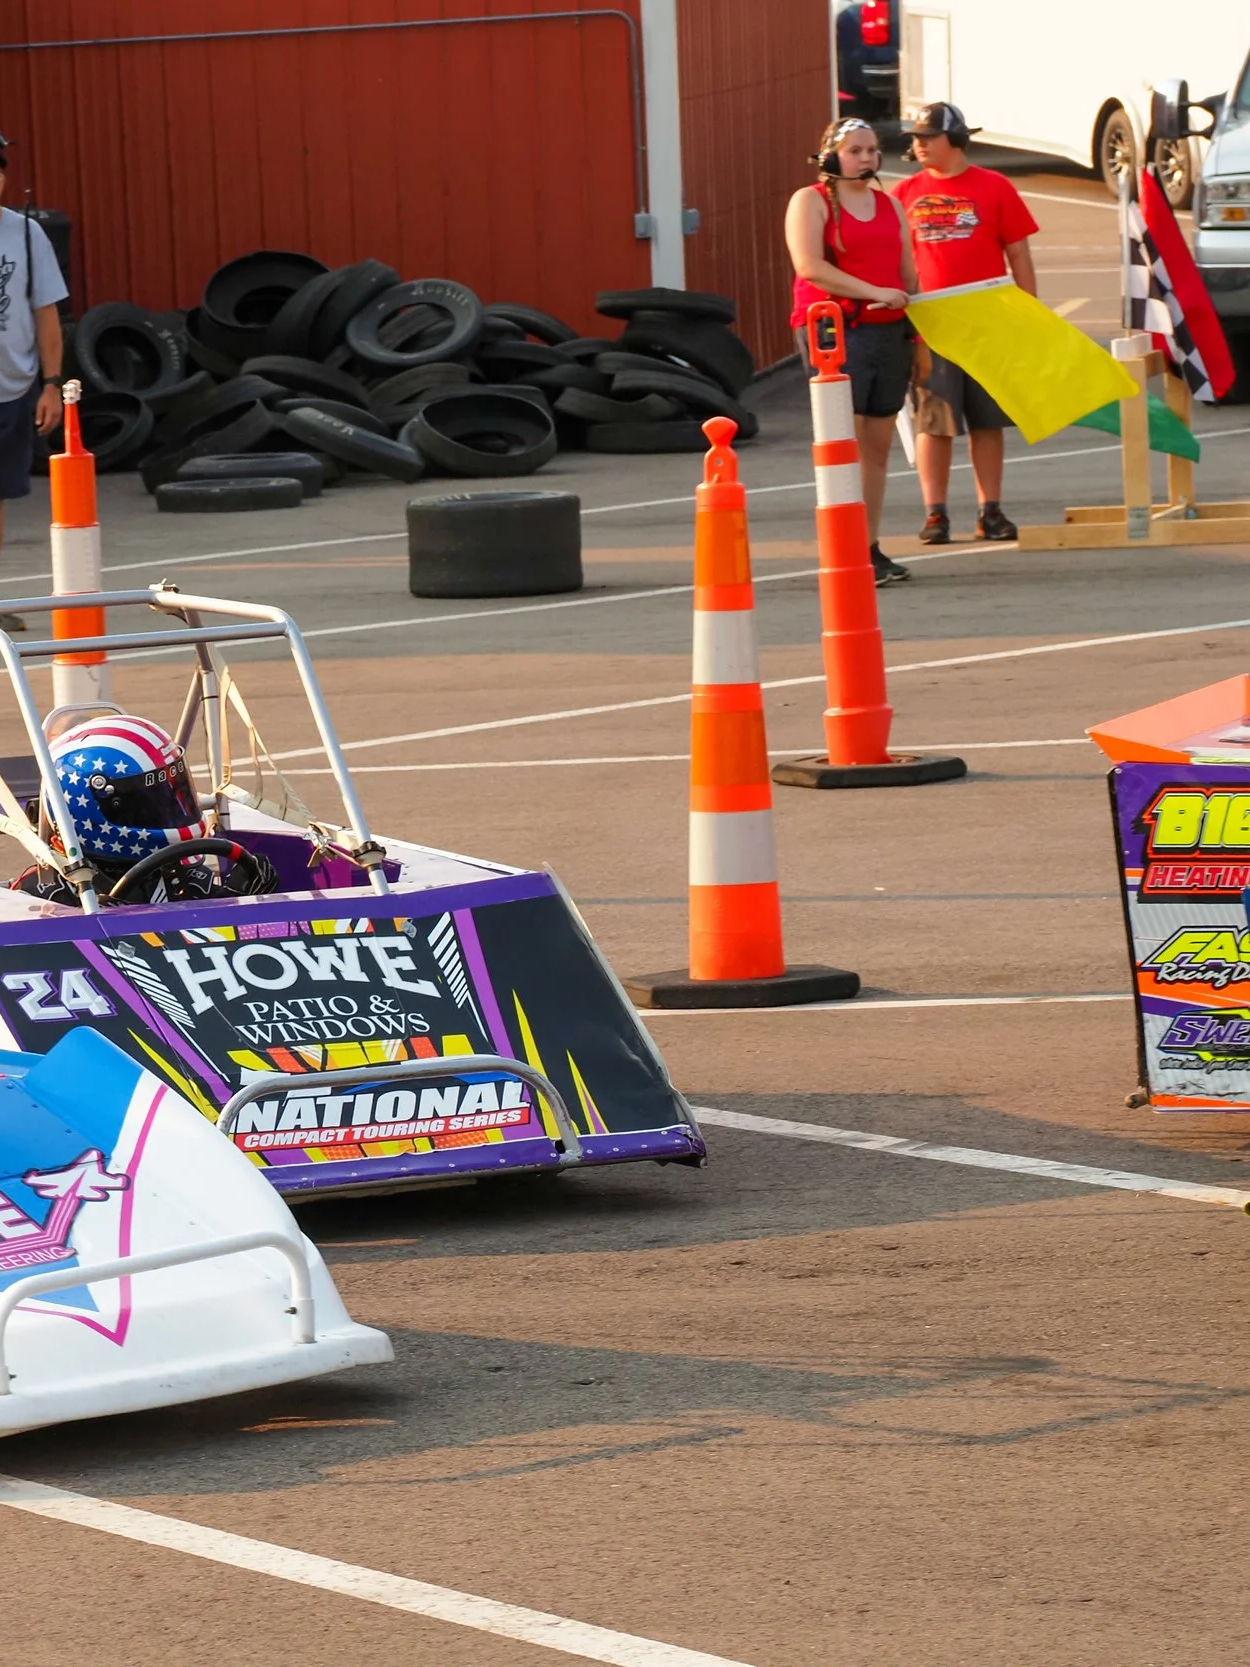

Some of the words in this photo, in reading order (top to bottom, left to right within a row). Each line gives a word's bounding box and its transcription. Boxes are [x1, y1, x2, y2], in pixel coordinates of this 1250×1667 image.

[1148, 866, 1250, 888] HEATIN
[1150, 930, 1250, 963] FA
[162, 933, 443, 1015] HOWE
[1157, 962, 1230, 987] Racing
[0, 969, 117, 1024] 24
[243, 995, 356, 1022] PATIO
[370, 992, 401, 1016] &
[236, 1012, 431, 1046] WINDOWS
[230, 1081, 530, 1133] NATIONAL
[244, 1130, 345, 1149] COMPACT
[350, 1118, 445, 1139] TOURING
[448, 1110, 522, 1130] SERIES
